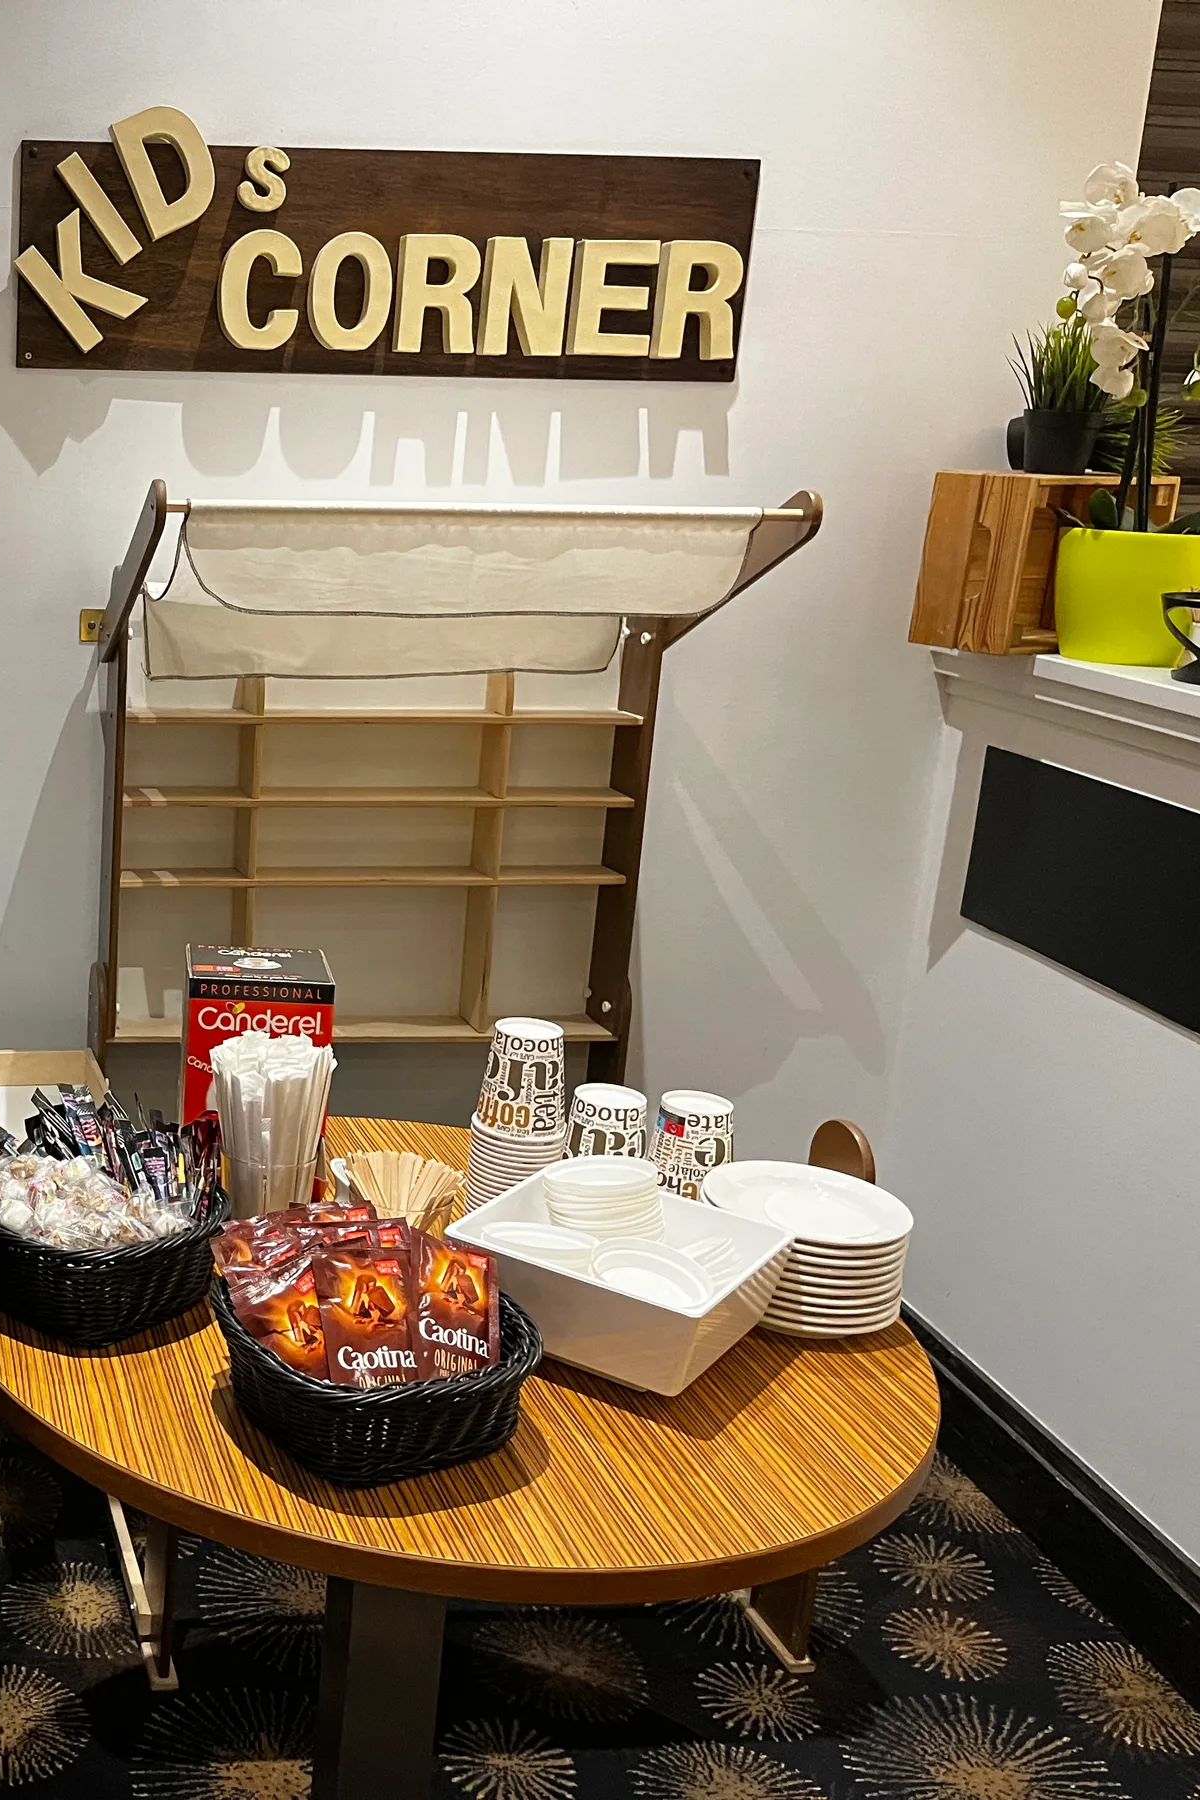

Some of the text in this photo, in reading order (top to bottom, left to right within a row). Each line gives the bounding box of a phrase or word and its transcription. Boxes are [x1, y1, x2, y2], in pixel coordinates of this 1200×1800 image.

[220, 229, 742, 360] CORNER
[200, 983, 322, 1000] PROFESSIONAL
[198, 1006, 323, 1035] Canderel
[418, 1317, 490, 1359] Caotina
[337, 1345, 417, 1370] Caotina
